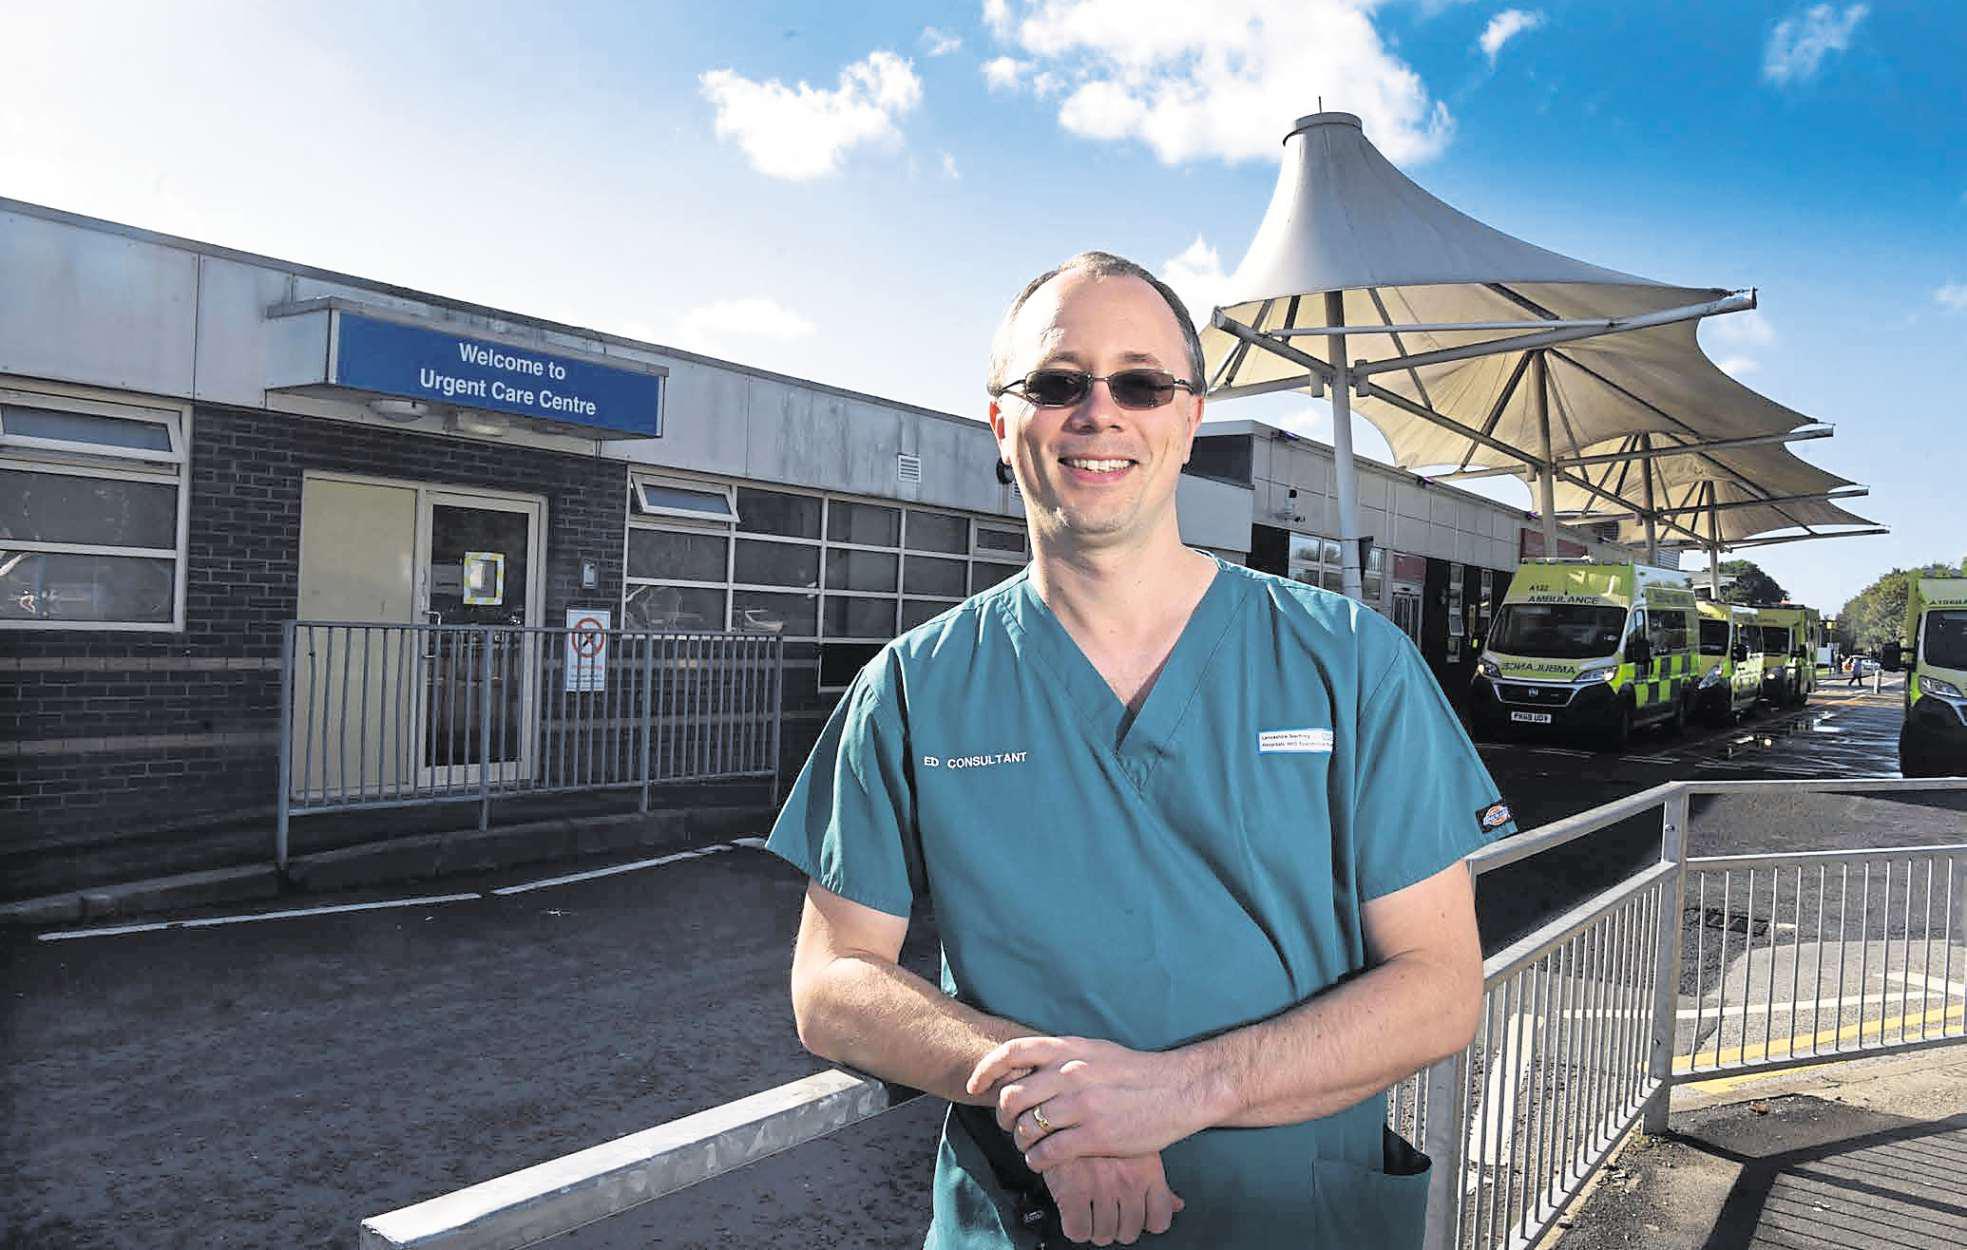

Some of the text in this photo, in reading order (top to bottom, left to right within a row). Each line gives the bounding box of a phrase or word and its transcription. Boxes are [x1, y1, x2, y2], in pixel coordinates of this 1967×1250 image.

[459, 342, 566, 381] Welcome to
[420, 368, 597, 415] Urgent Care Centre
[1528, 595, 1600, 604] AMBULANCE
[923, 751, 1027, 769] ED CONSULTANT
